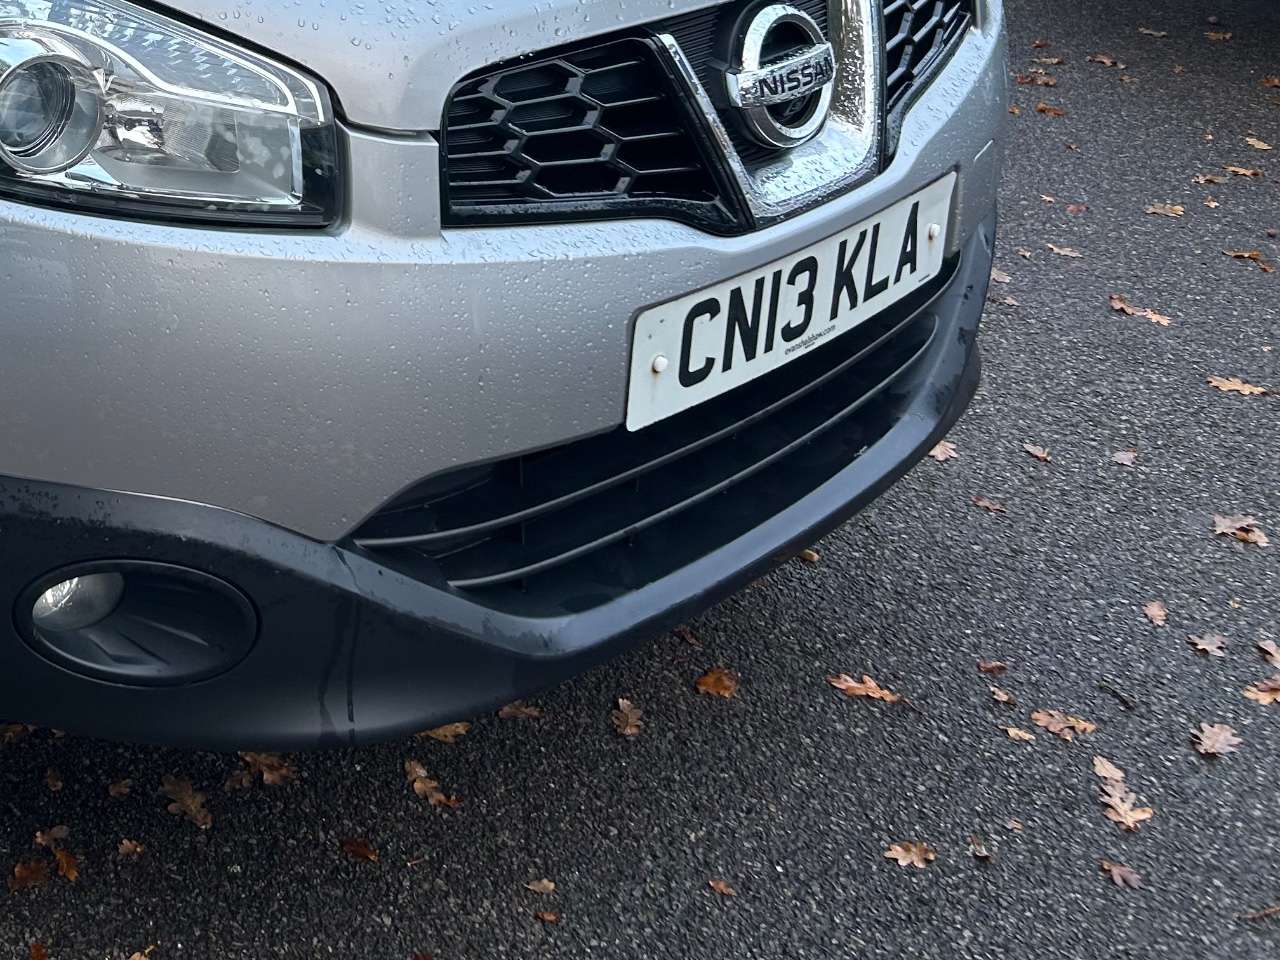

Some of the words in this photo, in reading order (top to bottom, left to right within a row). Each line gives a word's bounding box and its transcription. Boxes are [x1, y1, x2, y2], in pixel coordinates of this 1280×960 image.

[758, 56, 833, 98] NISSAN
[678, 255, 819, 388] CN13
[829, 200, 920, 322] KLA
